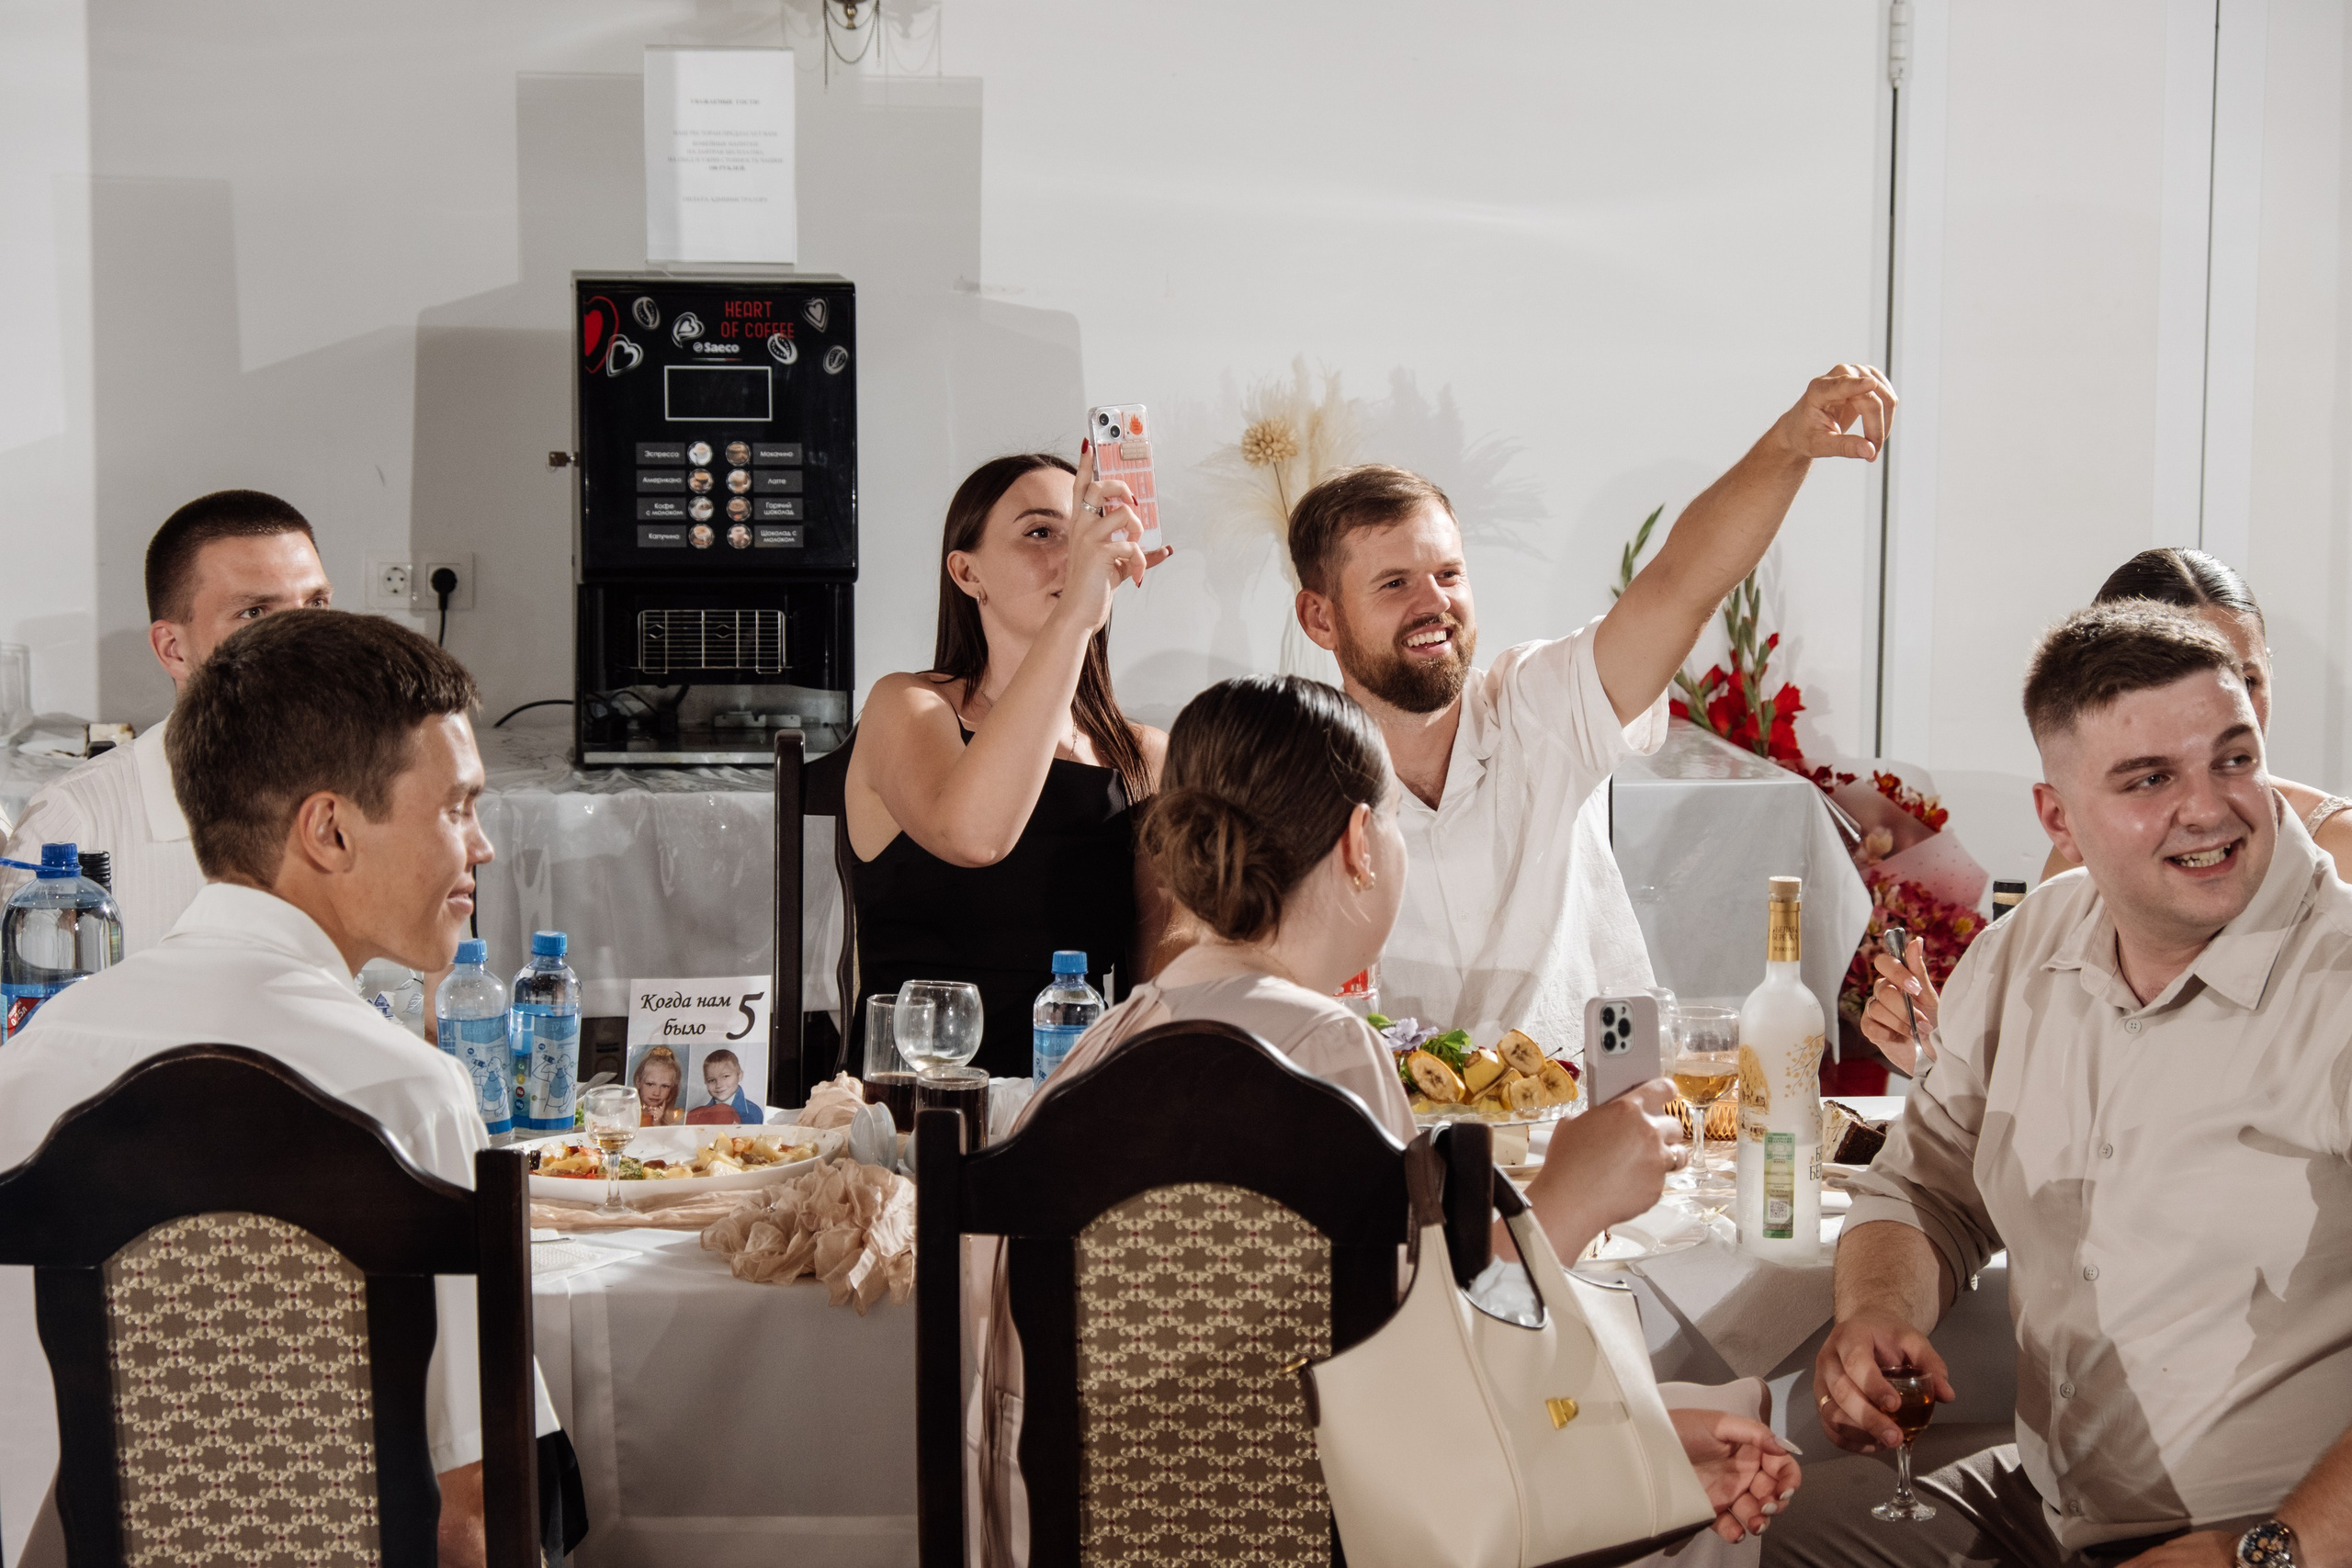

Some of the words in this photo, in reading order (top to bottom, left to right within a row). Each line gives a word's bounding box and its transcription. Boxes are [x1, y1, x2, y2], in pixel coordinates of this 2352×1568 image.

[725, 300, 772, 318] HEART
[720, 321, 739, 338] OF
[745, 322, 795, 339] COFFEE
[704, 342, 740, 353] Saeco
[640, 991, 692, 1011] Когда
[696, 996, 731, 1008] нам
[726, 991, 765, 1040] 5
[663, 1018, 706, 1036] было
